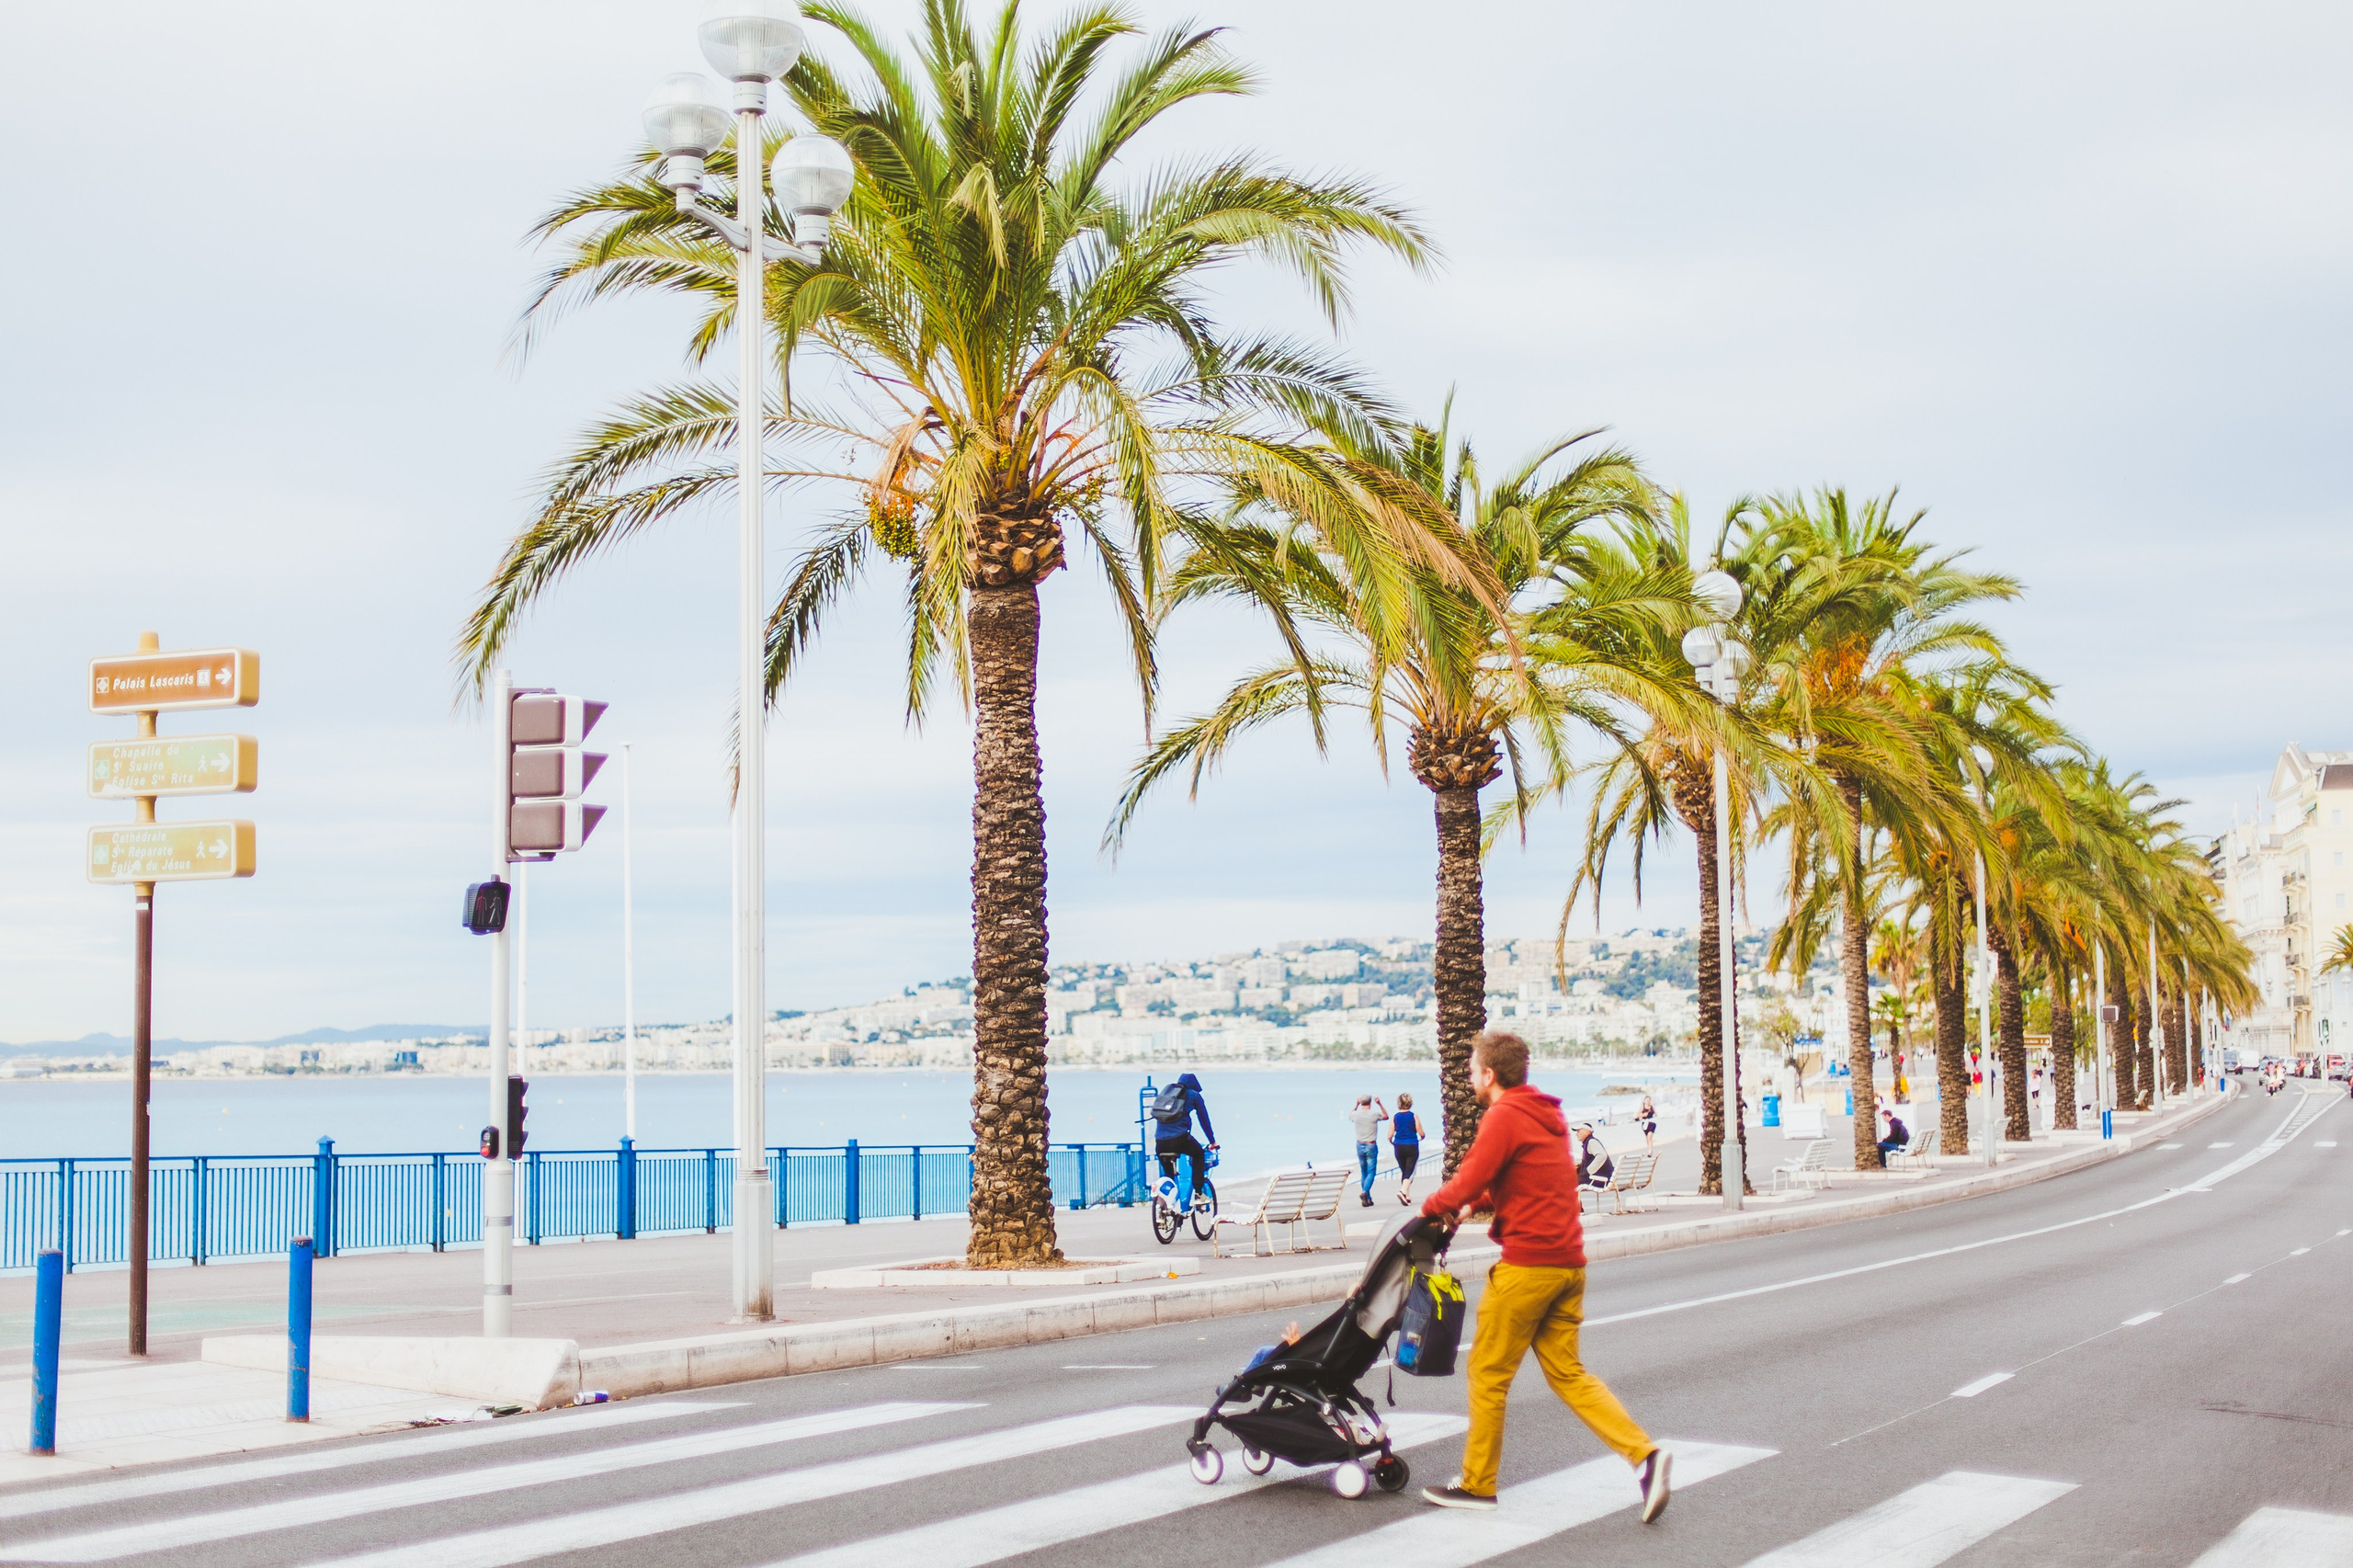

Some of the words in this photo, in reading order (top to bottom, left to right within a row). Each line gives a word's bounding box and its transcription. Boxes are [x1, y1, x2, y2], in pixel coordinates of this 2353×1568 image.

[113, 677, 145, 689] Palais
[151, 674, 194, 687] Lascaris
[113, 746, 161, 759] Chapelle
[167, 744, 179, 756] du
[130, 760, 164, 772] Suaire
[171, 772, 193, 783] Rita
[162, 858, 191, 870] Jésus
